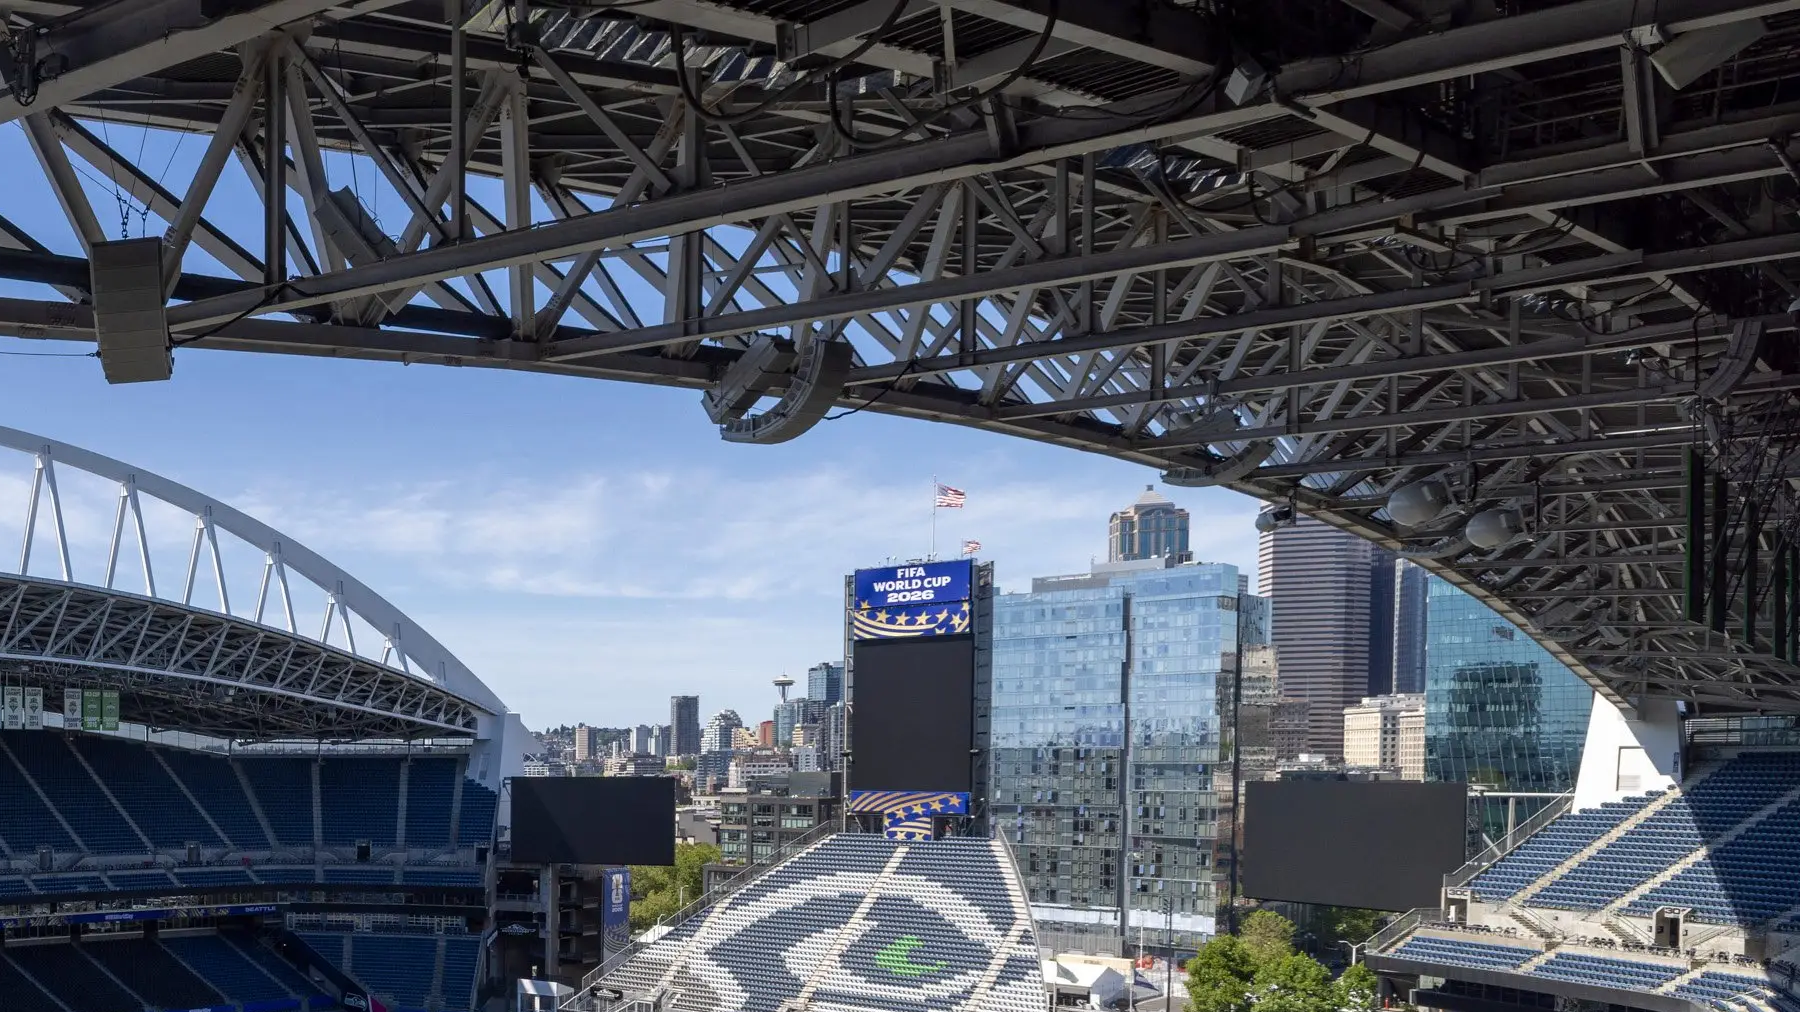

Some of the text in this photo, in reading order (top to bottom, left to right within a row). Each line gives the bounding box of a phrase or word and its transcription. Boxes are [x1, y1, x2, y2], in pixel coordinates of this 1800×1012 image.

[896, 567, 926, 578] FIFA
[873, 576, 952, 592] WORLD CUP
[887, 590, 934, 602] 2026
